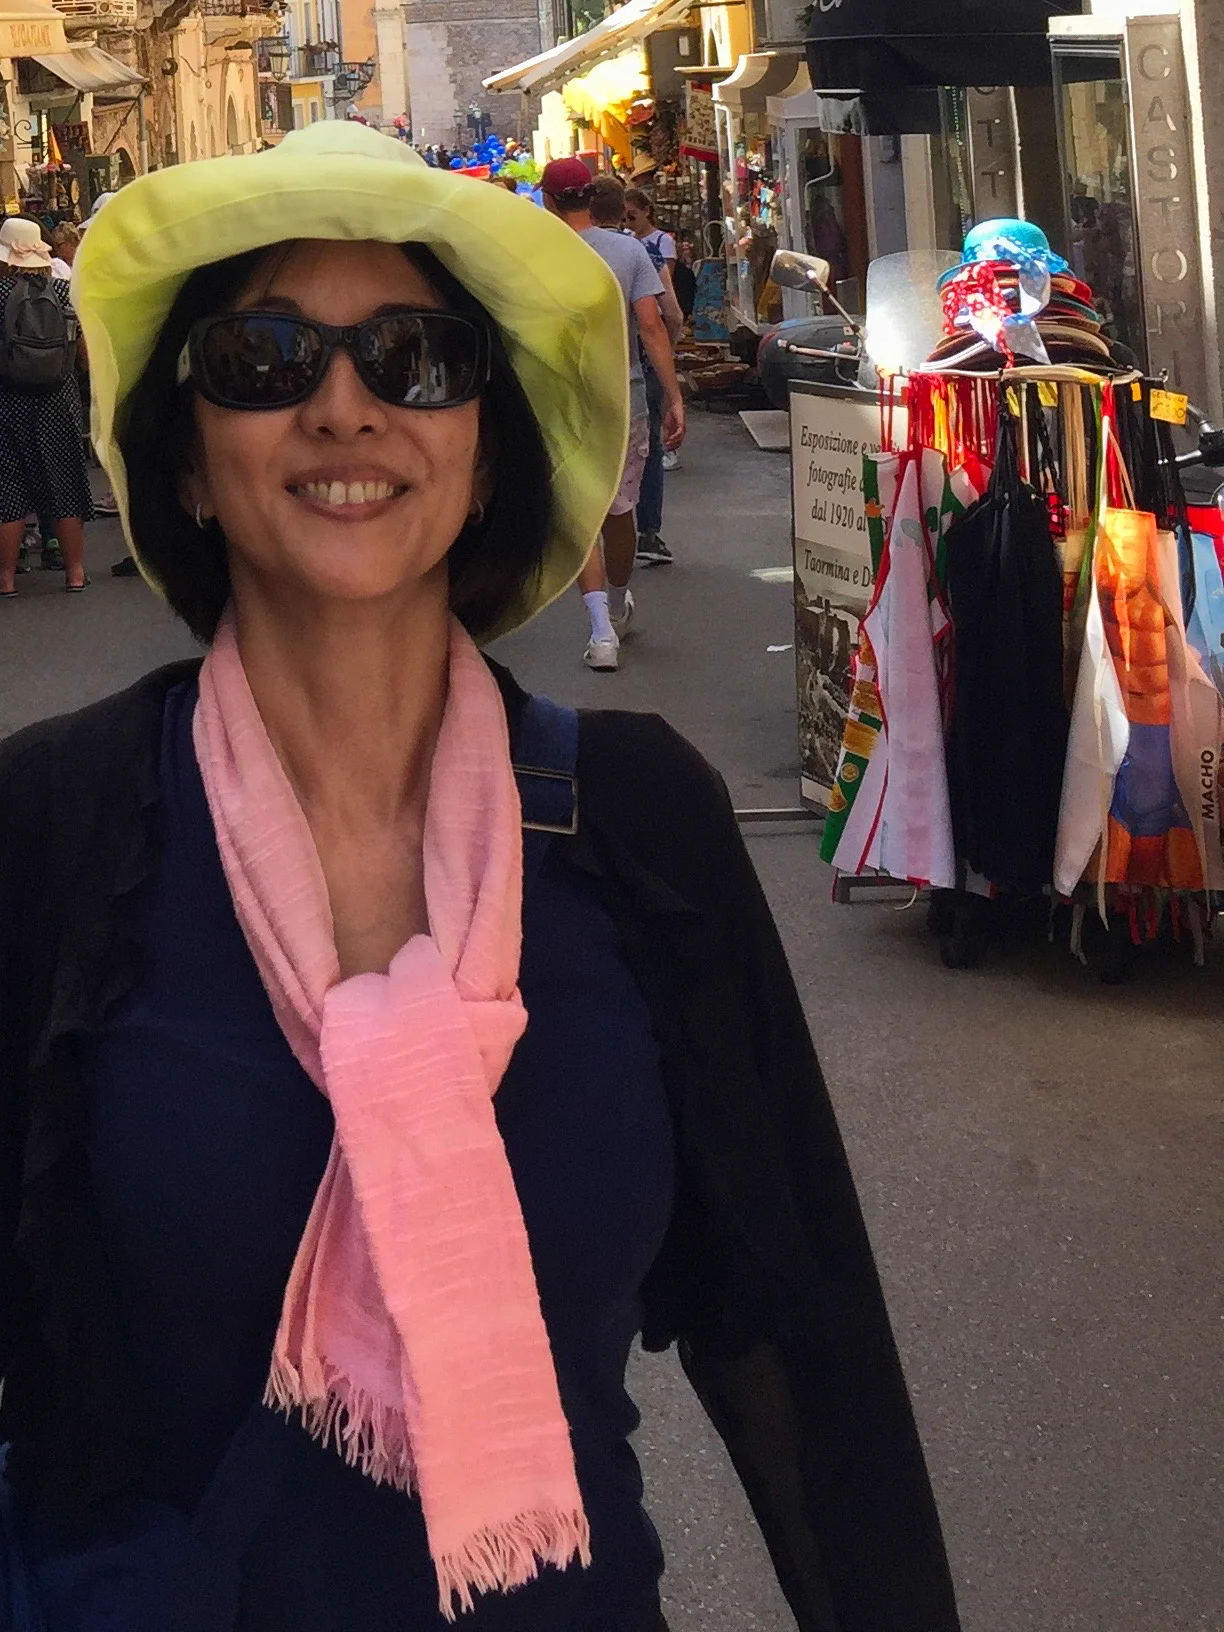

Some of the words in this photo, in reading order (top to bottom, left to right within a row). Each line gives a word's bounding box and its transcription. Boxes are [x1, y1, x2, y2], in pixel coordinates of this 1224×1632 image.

[801, 425, 859, 456] Esposizione
[807, 460, 857, 495] fotografie
[811, 498, 827, 524] dal
[831, 503, 855, 529] 1920
[804, 548, 850, 582] Taormina
[852, 569, 859, 583] e
[1200, 750, 1215, 821] MACHO
